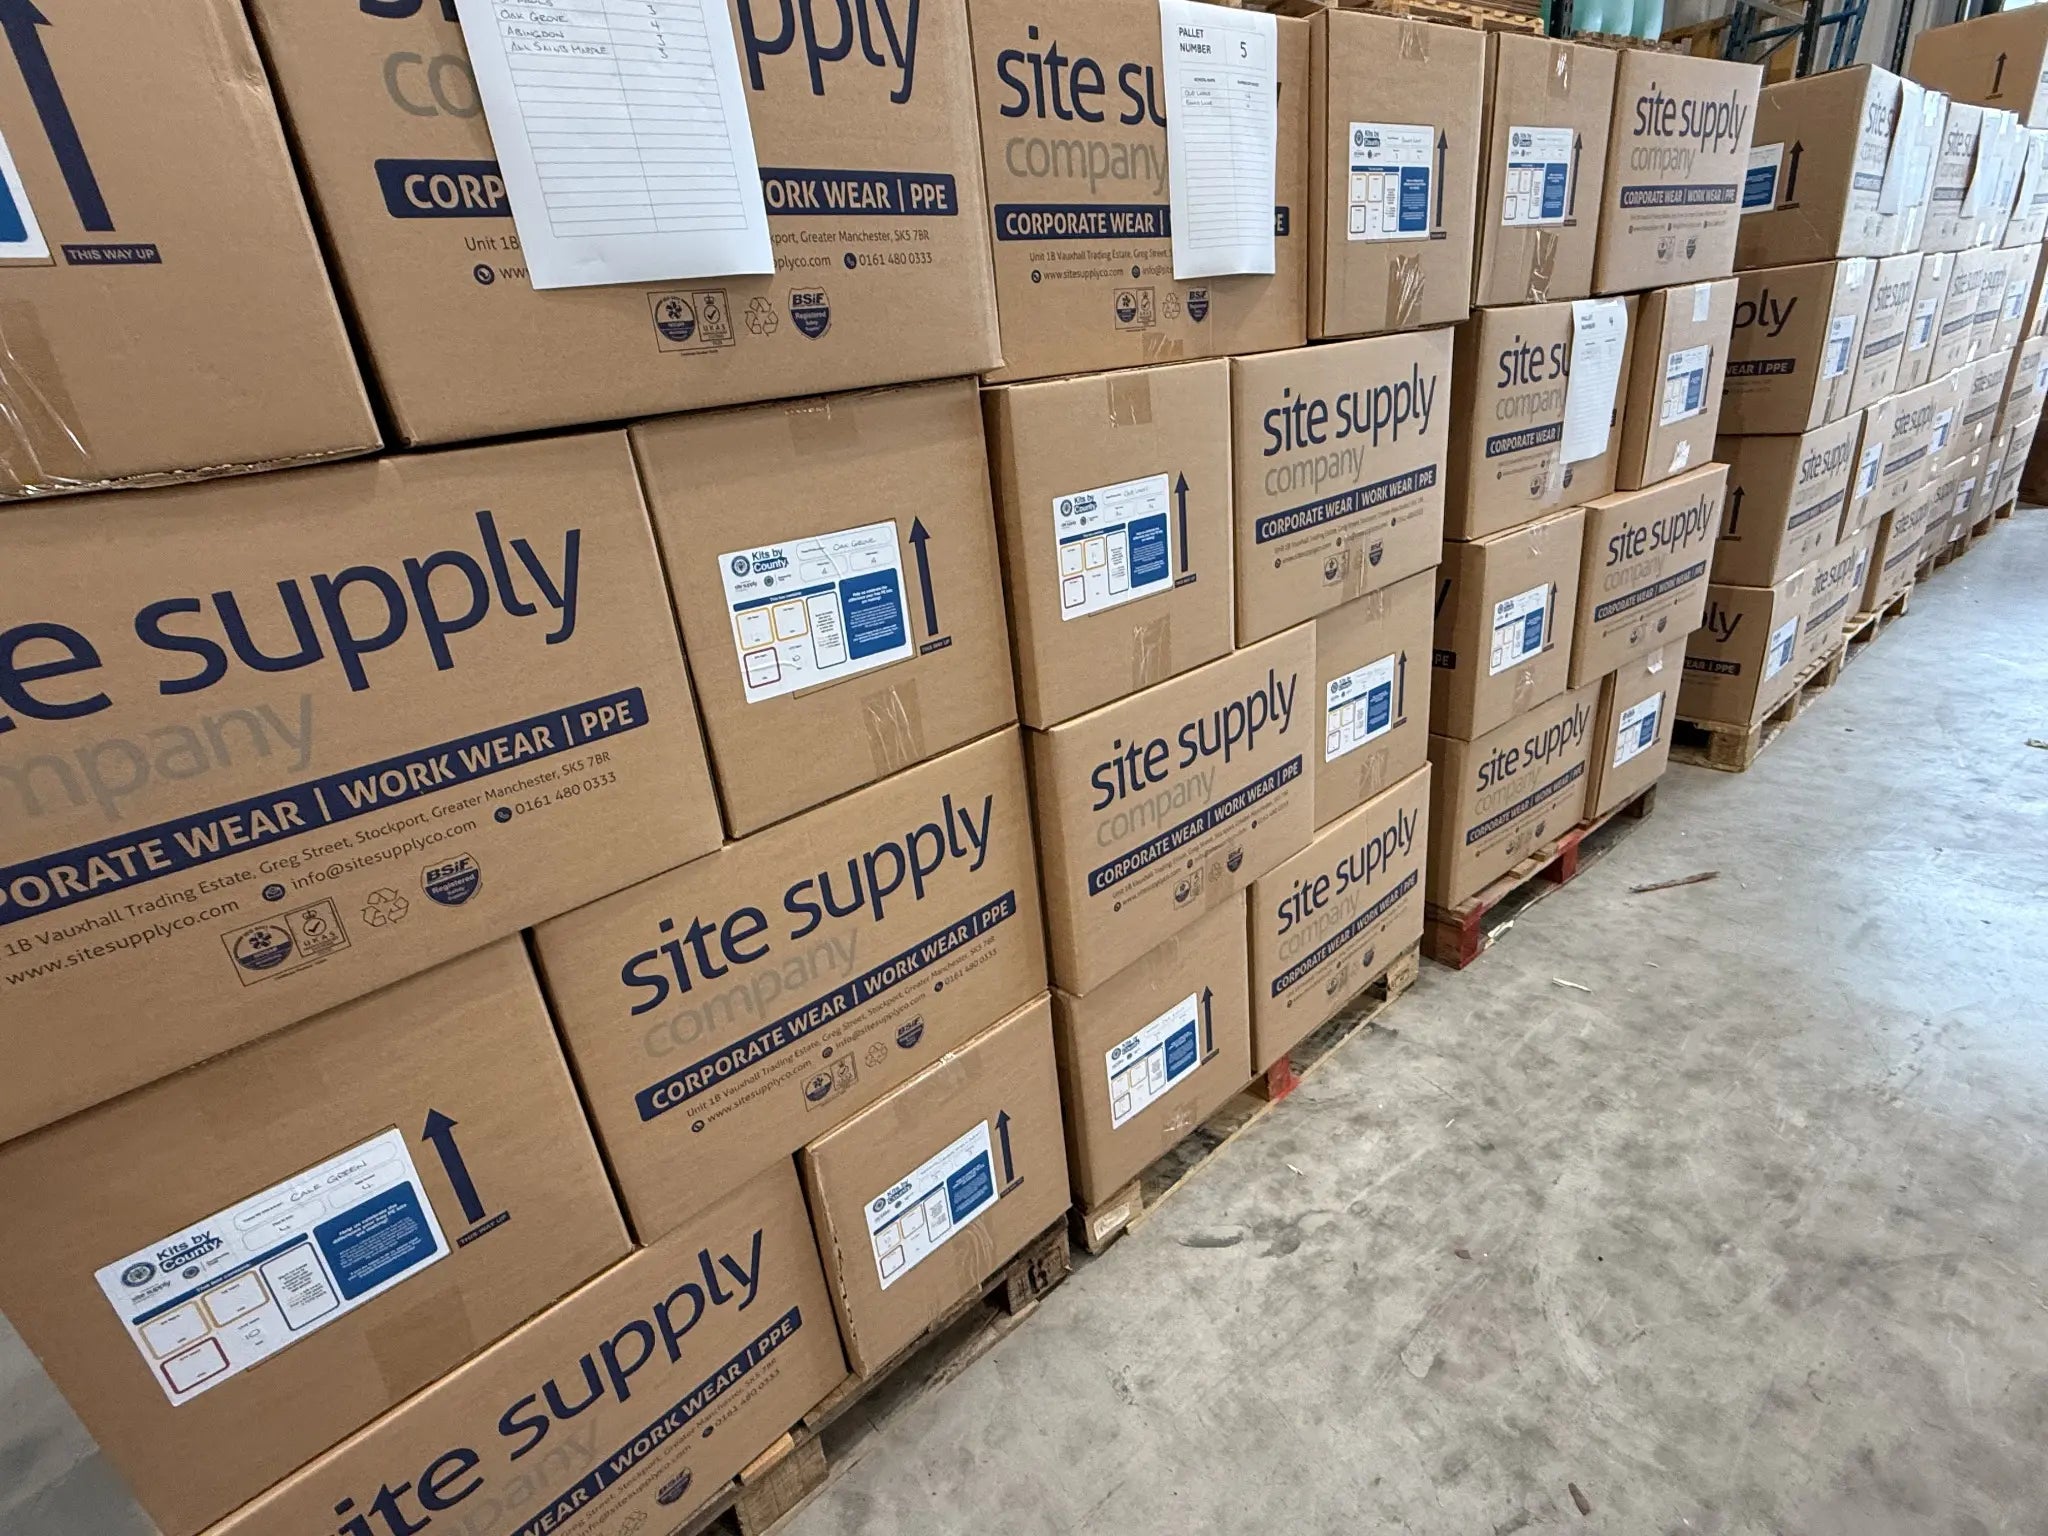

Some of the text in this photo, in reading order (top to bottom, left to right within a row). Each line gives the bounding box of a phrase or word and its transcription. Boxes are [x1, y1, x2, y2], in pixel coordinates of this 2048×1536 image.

[507, 26, 565, 39] ABINGDON
[530, 11, 568, 23] GROVE
[651, 21, 660, 30] 4
[1178, 27, 1204, 38] PALLET
[997, 25, 1106, 122] site
[1179, 41, 1248, 58] NUMBER 5
[1633, 82, 1748, 154] site supply
[1006, 137, 1167, 196] company
[1630, 145, 1696, 179] company
[763, 179, 948, 210] ORK WEAR PPE
[1623, 191, 1665, 206] CORPORATE
[464, 236, 497, 252] Unit
[800, 230, 837, 243] Greater
[838, 230, 893, 245] Manchester,
[894, 230, 912, 242] SK5
[1006, 212, 1155, 235] CORPORATE WEAR
[68, 248, 156, 261] THIS WAY UP
[858, 252, 933, 267] 0161 480 0333
[1043, 267, 1124, 281] www.sitesupplyco.com
[1057, 250, 1086, 261] Vauxhall
[1087, 249, 1111, 262] Trading
[1497, 335, 1545, 389] site
[1765, 362, 1788, 372] PPE
[1263, 362, 1437, 457] site supply
[1489, 427, 1556, 455] CORPORATE WEAR
[1264, 444, 1366, 497] company
[1261, 507, 1324, 540] CORPORATE
[1325, 497, 1353, 519] WEAR
[1361, 485, 1388, 506] WORK
[1389, 477, 1413, 498] WEAR
[1418, 469, 1434, 489] PPE
[1607, 494, 1715, 567] site supply
[752, 547, 783, 561] Kits by
[1603, 554, 1666, 592] company
[134, 511, 583, 695] supply
[1090, 737, 1170, 812] site
[1177, 668, 1298, 769] supply
[1476, 703, 1590, 792] site supply
[173, 698, 635, 861] WEAR WORK WEAR PPE
[1474, 766, 1542, 816] company
[1096, 766, 1216, 848] company
[1096, 837, 1170, 888] CORPORATE
[1171, 819, 1204, 847] WEAR
[1214, 795, 1247, 822] WORK
[1247, 778, 1275, 803] WEAR
[1281, 761, 1299, 783] PPE
[1469, 809, 1511, 843] CORPORATE
[5, 899, 240, 986] www.sitesupplyco.com
[290, 818, 477, 893] info@sitesupplyco.com
[515, 793, 552, 817] 0161
[554, 783, 581, 803] 480
[582, 771, 618, 795] 0333
[6, 749, 612, 958] 1B Vauxhall Trading Estate, Greg Street, Stockport, Greater Manchester, SK5 7BR
[426, 856, 472, 882] BSiF
[1278, 875, 1331, 936] site
[1335, 807, 1418, 896] supply
[431, 873, 475, 895] Registered
[621, 794, 994, 1016] site supply
[1276, 947, 1328, 991] CORPORATE
[1327, 929, 1351, 954] WEAR
[1356, 908, 1379, 932] WORK
[1379, 891, 1400, 913] WEAR
[643, 927, 859, 1059] company
[651, 898, 1009, 1111] CORPORATE WEAR WORK WEAR PPE
[686, 1104, 708, 1118] Unit
[723, 1070, 762, 1098] Vauxhall
[761, 1055, 793, 1080] Trading
[821, 1028, 843, 1045] Greg
[903, 976, 931, 995] Greater
[707, 1059, 813, 1124] www.sitesupplyco.com
[944, 968, 965, 986] 0161
[978, 947, 998, 965] 0333
[156, 1230, 211, 1261] Kits by
[498, 1228, 763, 1461] supply
[609, 1412, 682, 1476] WORK
[681, 1362, 743, 1417] WEAR
[758, 1316, 793, 1356] PPE
